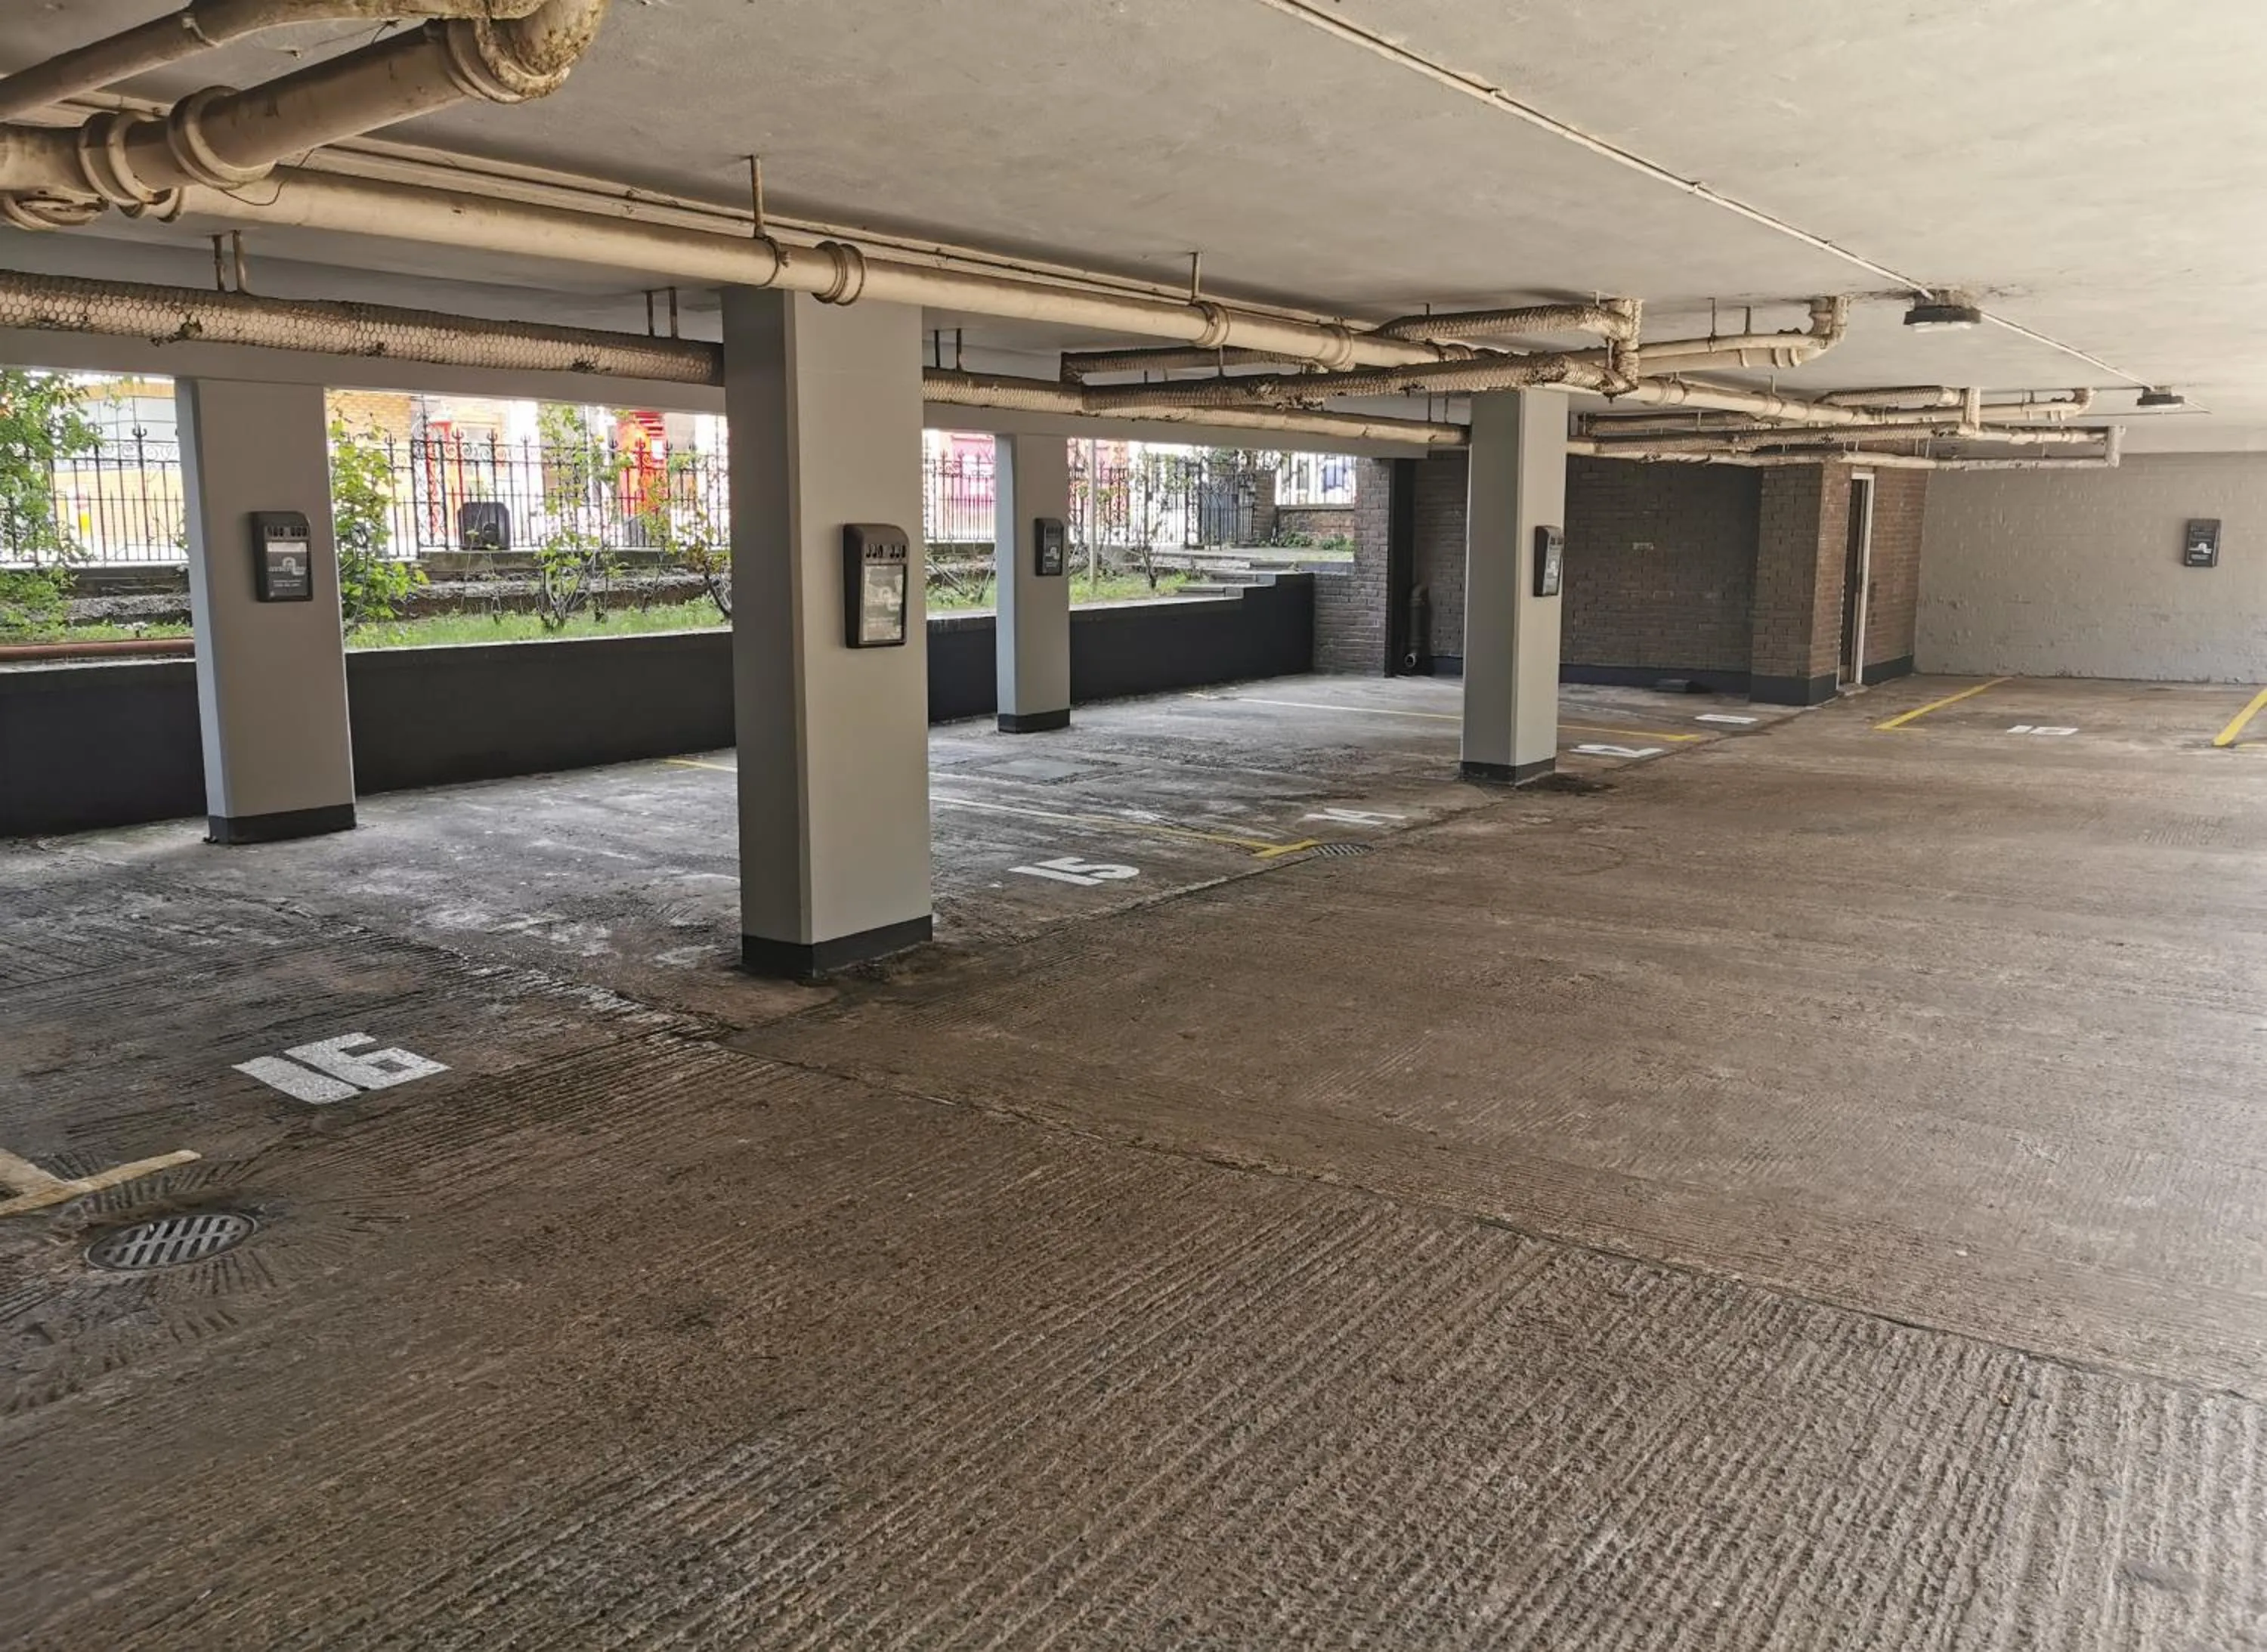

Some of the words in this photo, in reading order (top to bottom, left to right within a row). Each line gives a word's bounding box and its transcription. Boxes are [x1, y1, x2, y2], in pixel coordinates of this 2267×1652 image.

[1568, 744, 1662, 757] 12
[1305, 808, 1406, 824] 14
[1007, 857, 1140, 886] 15
[230, 1032, 452, 1104] 16
